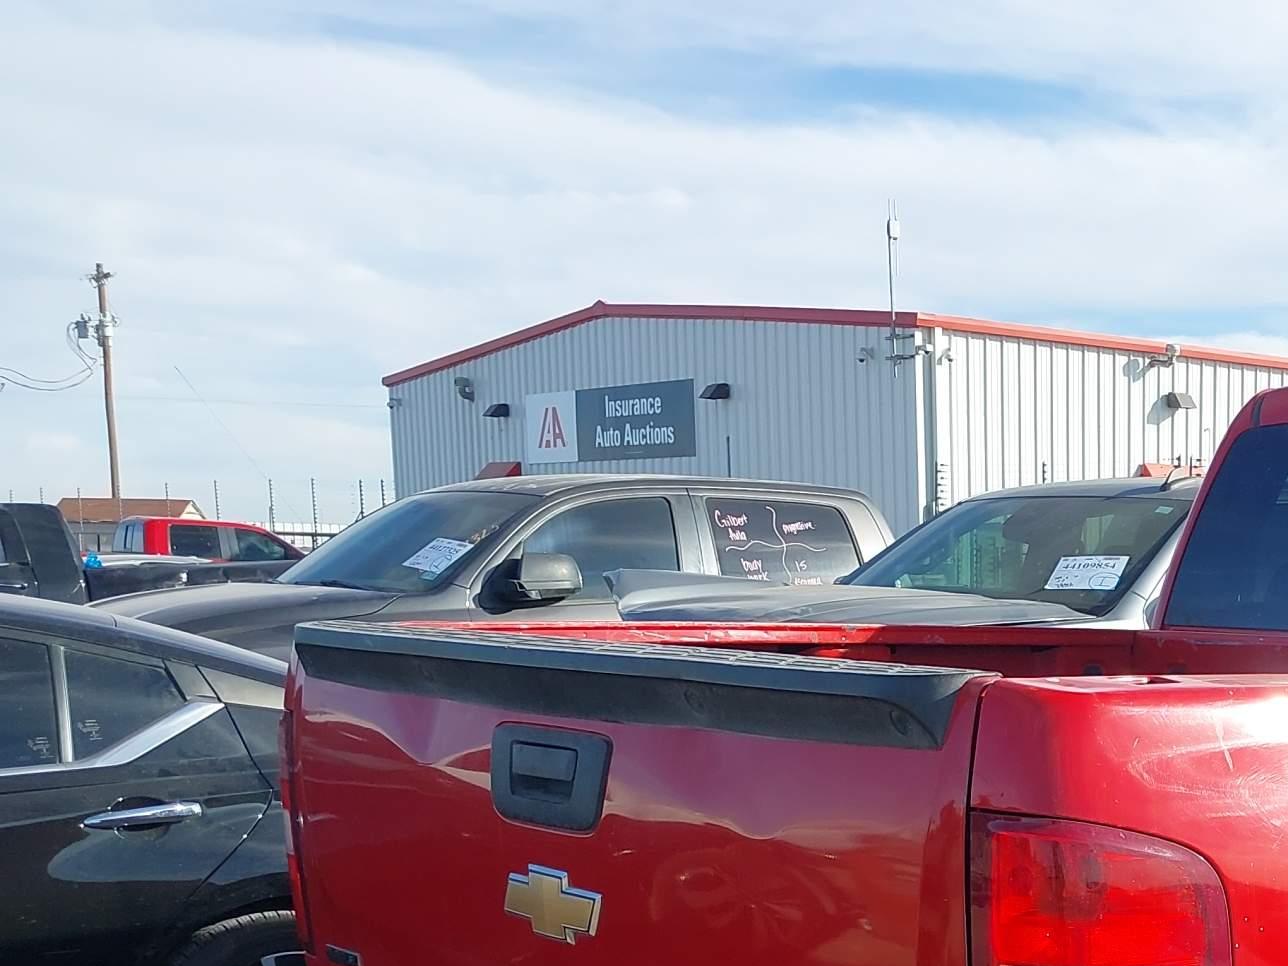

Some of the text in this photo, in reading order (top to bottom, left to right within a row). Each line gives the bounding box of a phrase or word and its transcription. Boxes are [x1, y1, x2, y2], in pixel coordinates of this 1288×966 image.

[604, 394, 662, 418] Insurance
[595, 420, 675, 449] Auto Auctions
